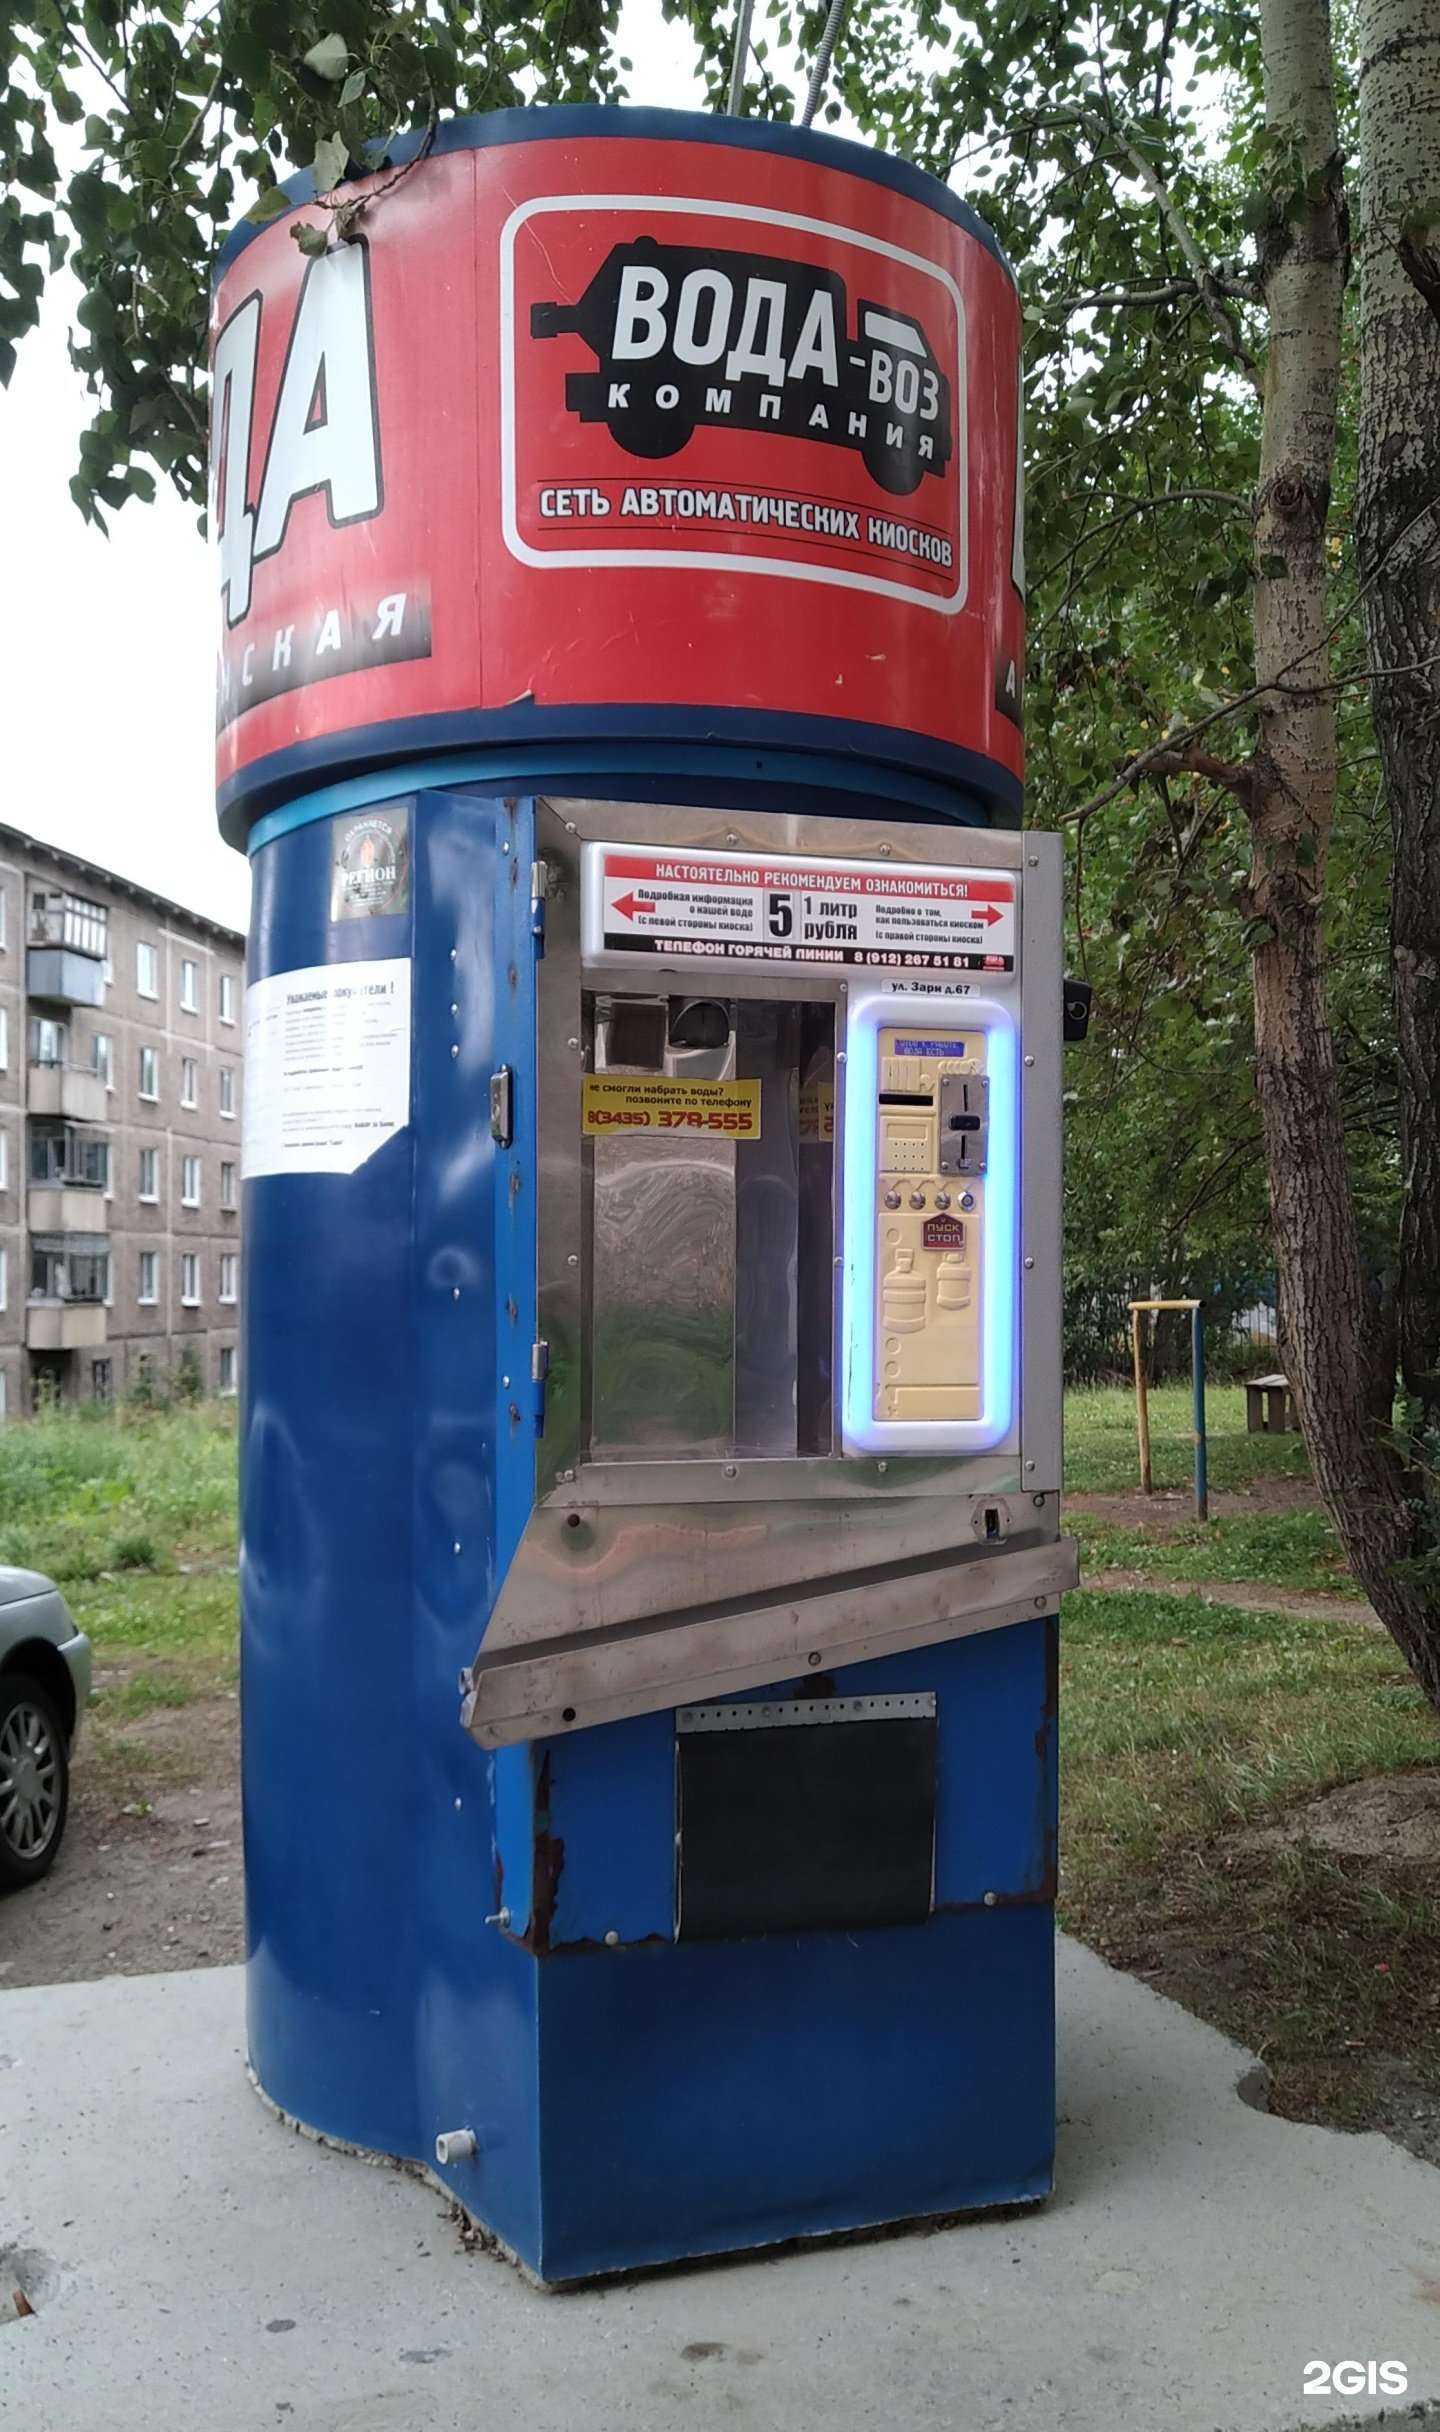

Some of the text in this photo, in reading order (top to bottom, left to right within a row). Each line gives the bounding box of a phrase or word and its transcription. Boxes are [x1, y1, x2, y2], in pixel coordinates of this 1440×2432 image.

[608, 382, 935, 460] КОМПАНИЯ
[540, 487, 953, 568] СЕТЬ АВТОМАТИЧЕСКИХ КИОСКОВ
[656, 863, 968, 898] НАСТОЯТЕЛЬНО РЕКОМЕНДУЕМ ОЗНАКОМИТЬСЯ!
[638, 889, 753, 907] Подробная информация
[689, 905, 753, 919] о нашей воде
[804, 897, 858, 919] 1 литр
[875, 904, 916, 917] Подробно
[769, 894, 793, 937] 5
[649, 917, 676, 927] левой
[678, 919, 717, 930] стороны
[804, 921, 858, 940] рубля
[875, 917, 984, 930] как пользоваться киоском
[885, 931, 915, 942] правой
[916, 933, 951, 943] стороны
[654, 939, 726, 956] ТЕЛЕФОН
[728, 943, 792, 959] ГОРЯЧЕЙ
[795, 948, 844, 962] ЛИНИИ
[854, 951, 863, 963] 8
[866, 952, 902, 967] (912)
[904, 954, 930, 966] 267
[891, 981, 909, 993] ул.
[944, 984, 971, 995] д.67
[602, 1084, 641, 1094] смогли
[644, 1086, 688, 1097] набрать
[690, 1087, 724, 1097] воды?
[625, 1096, 752, 1109] позвоните по телефону
[588, 1110, 752, 1131] 8(3435) 378-555
[927, 1223, 960, 1232] ПУСК
[927, 1234, 961, 1243] СТОП
